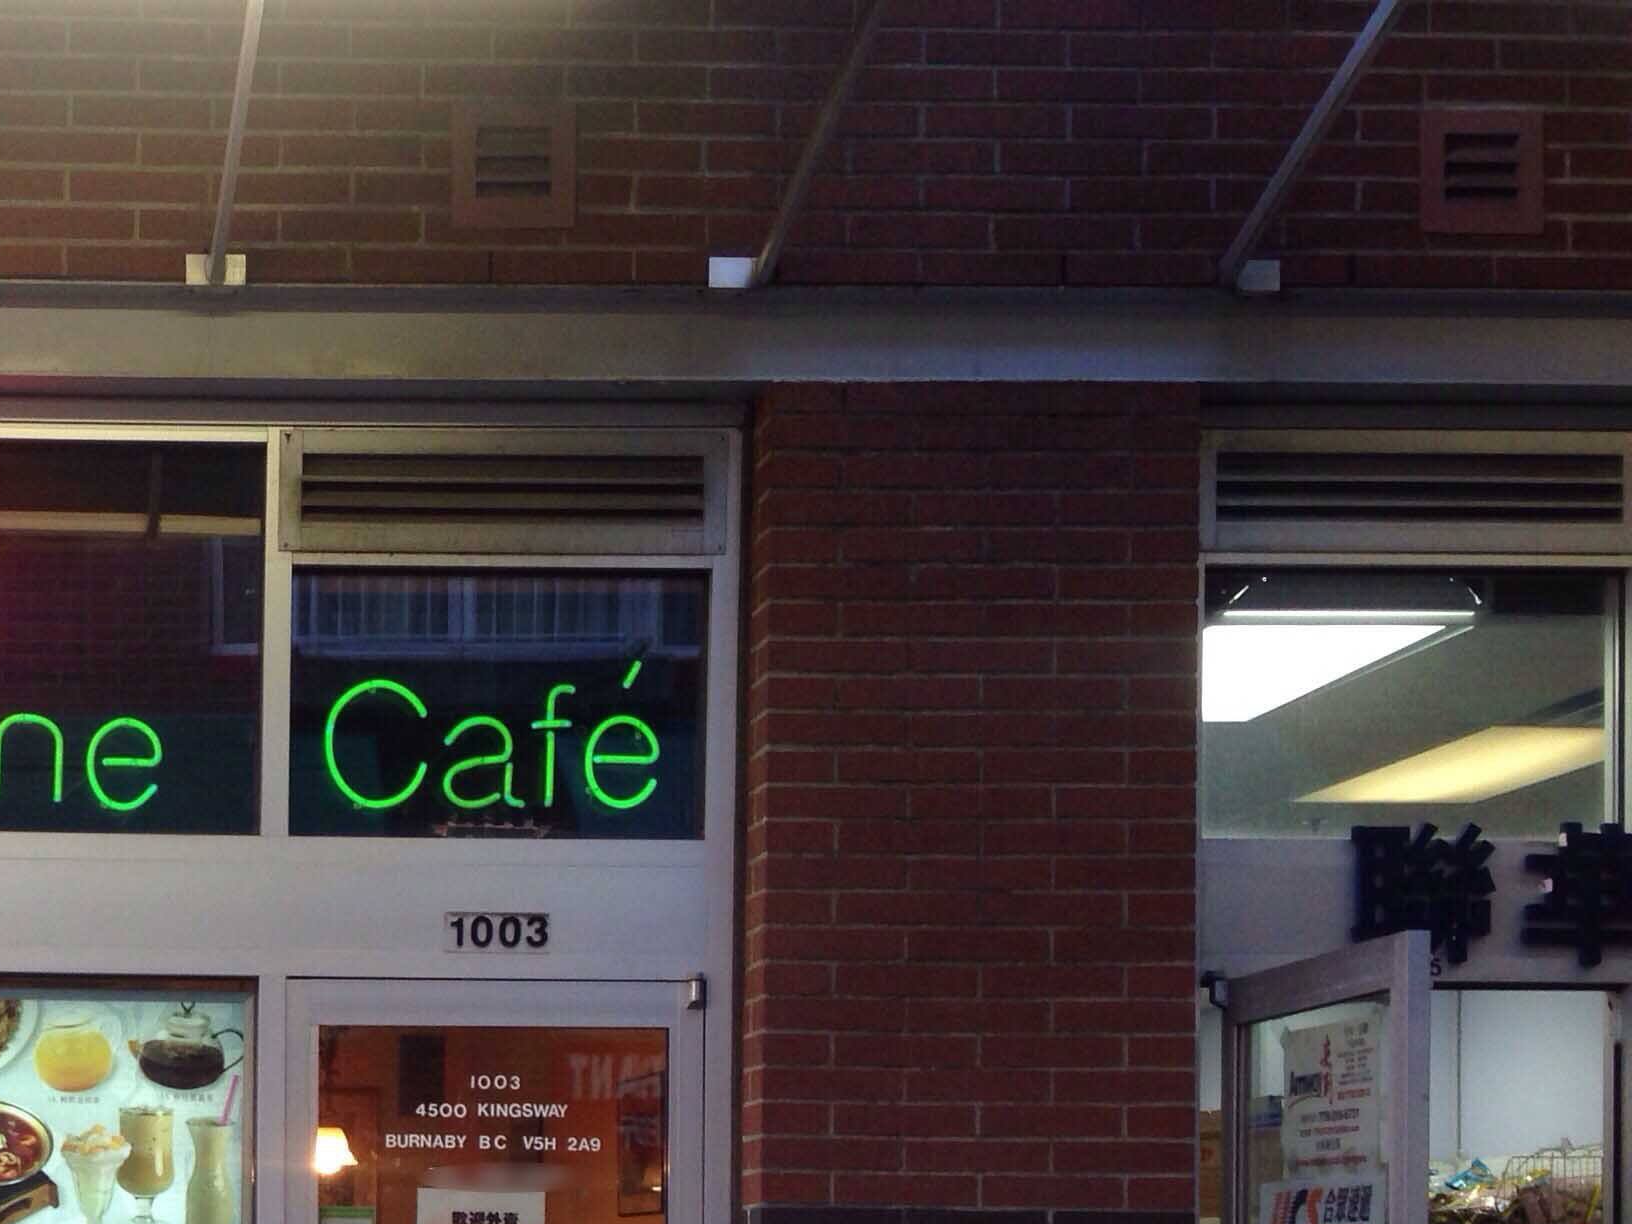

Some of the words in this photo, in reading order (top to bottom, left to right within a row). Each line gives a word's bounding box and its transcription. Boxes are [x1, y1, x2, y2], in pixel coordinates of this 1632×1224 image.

[324, 660, 661, 809] Café
[449, 915, 550, 949] 1003
[470, 1075, 521, 1091] 1003
[415, 1103, 468, 1119] 4500
[477, 1103, 568, 1119] KINGSWAY
[385, 1134, 467, 1150] BURNABY
[522, 1136, 557, 1151] V5H
[567, 1137, 601, 1153] 2A9
